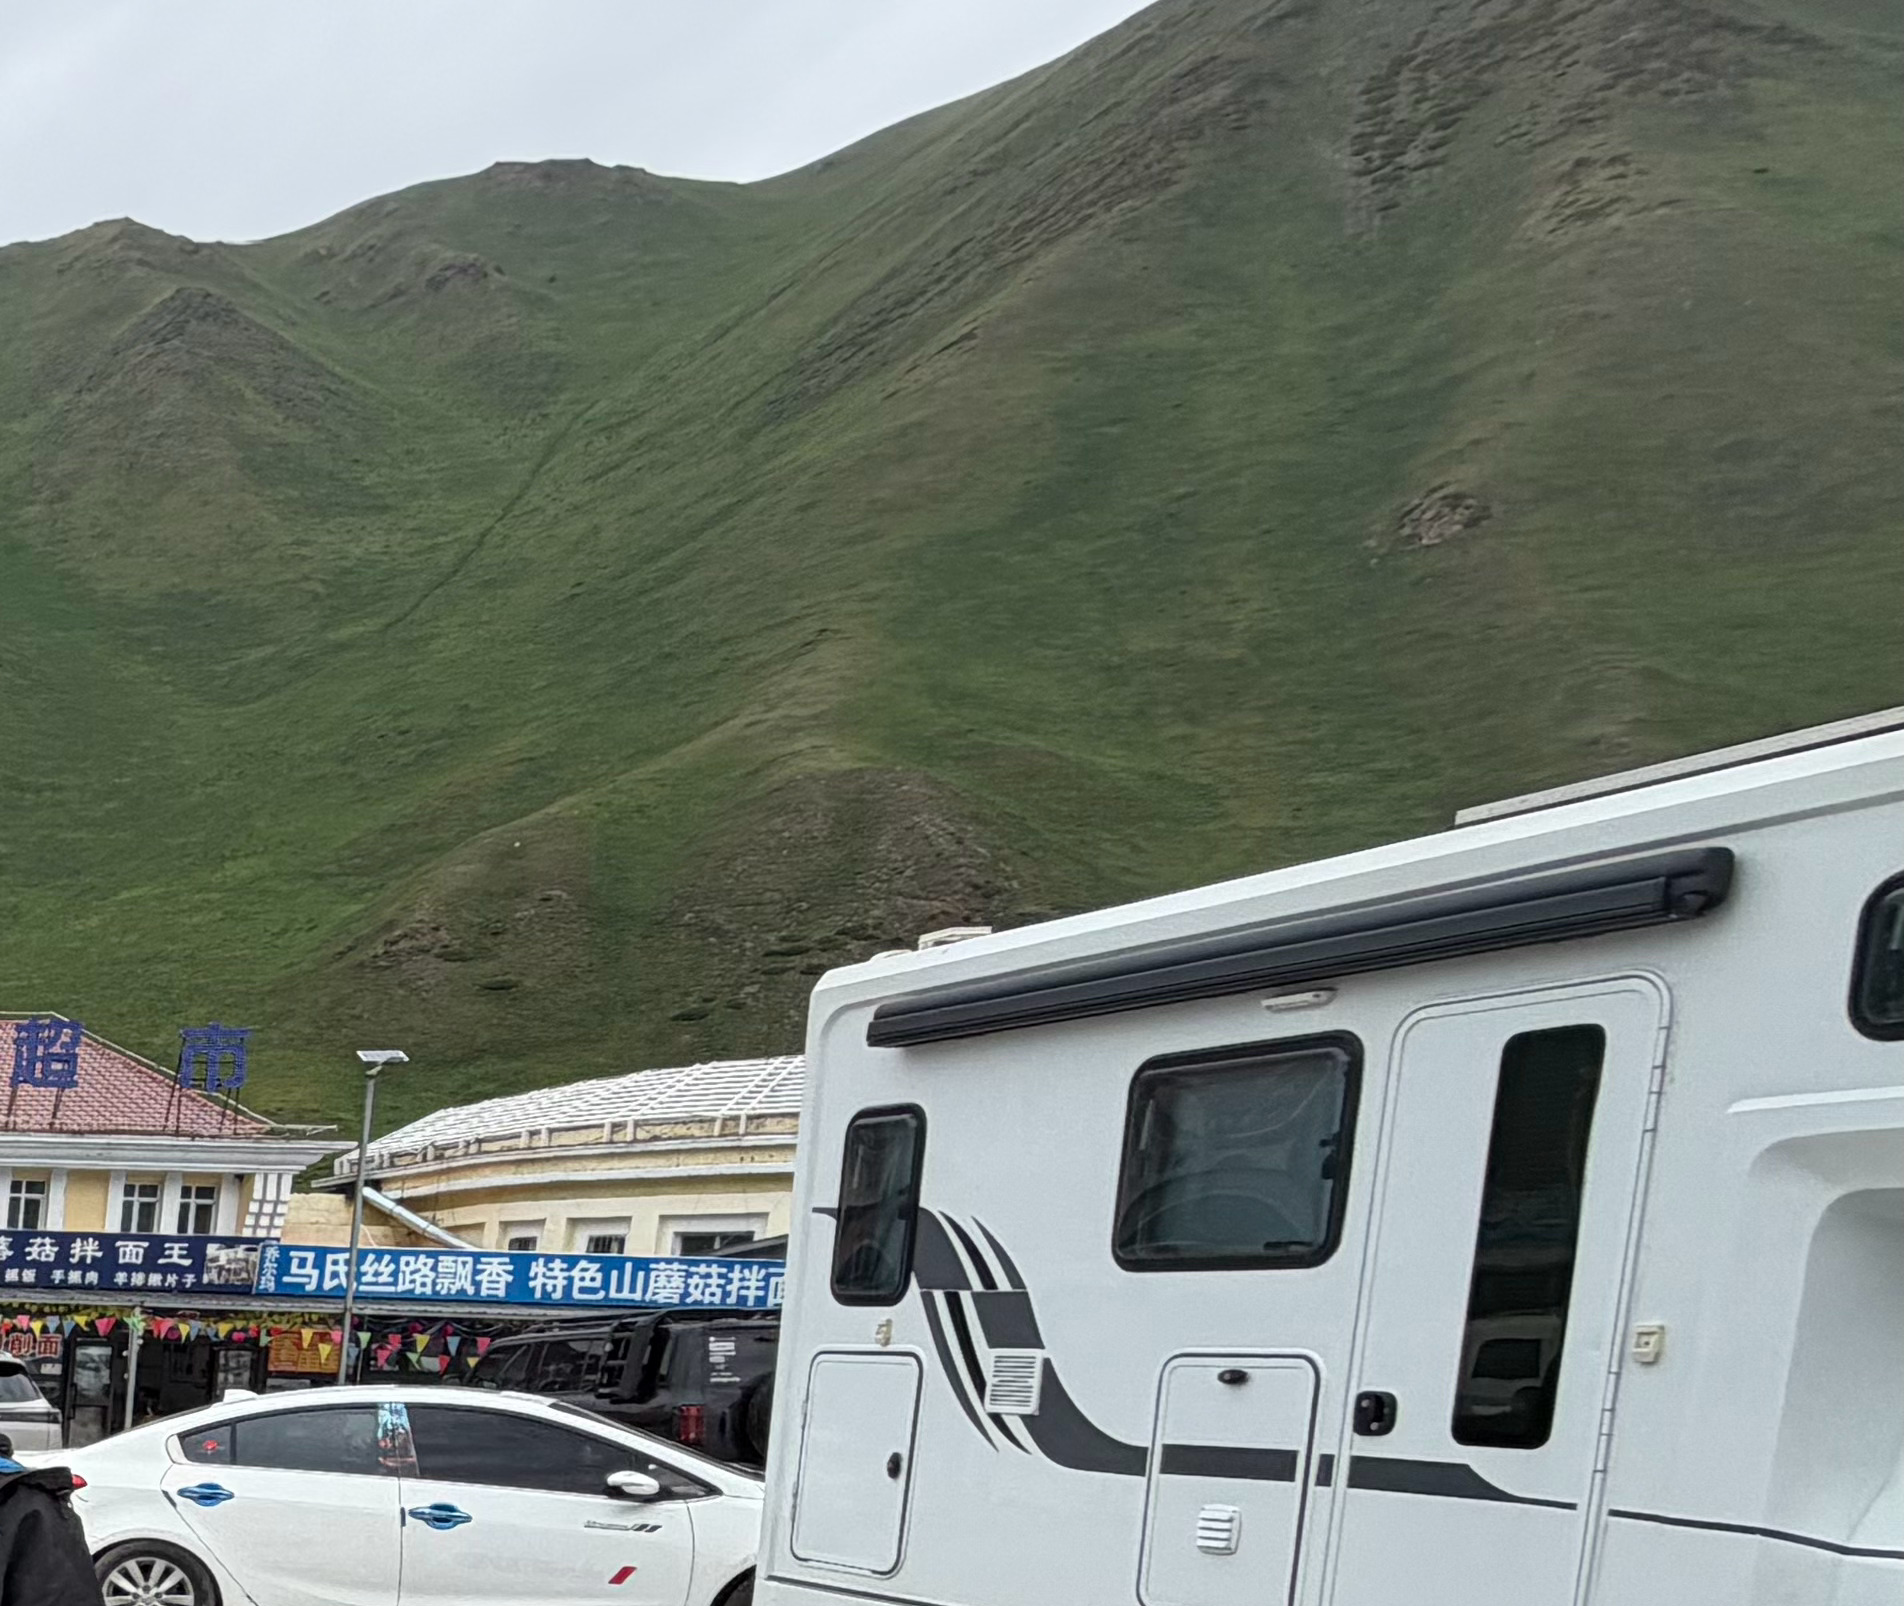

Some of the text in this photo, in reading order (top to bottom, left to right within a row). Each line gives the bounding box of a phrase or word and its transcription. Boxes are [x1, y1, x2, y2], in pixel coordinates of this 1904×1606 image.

[282, 1250, 515, 1298] 马氏丝路飘香
